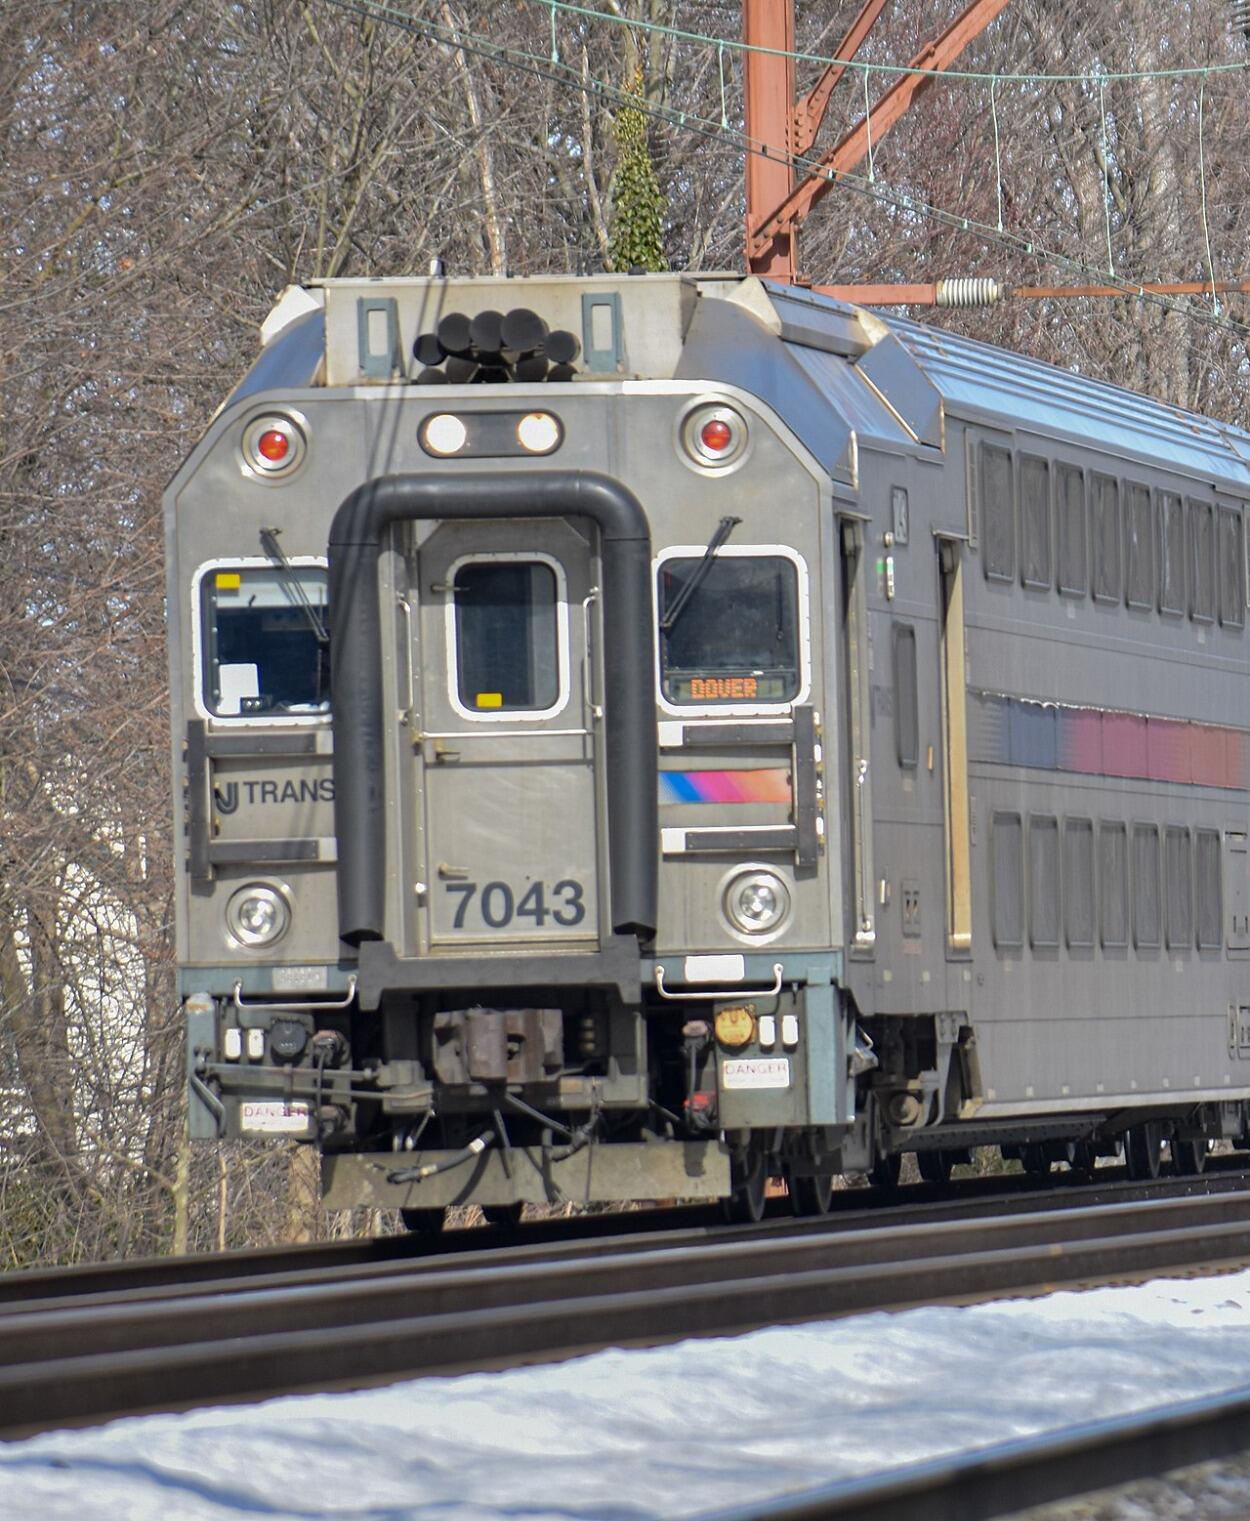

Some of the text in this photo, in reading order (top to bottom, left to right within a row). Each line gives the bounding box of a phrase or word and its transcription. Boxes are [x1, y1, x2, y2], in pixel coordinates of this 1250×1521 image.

[691, 678, 757, 699] DOVER
[243, 779, 335, 803] TRANS
[446, 880, 586, 928] 7043
[725, 1063, 787, 1075] DANGER
